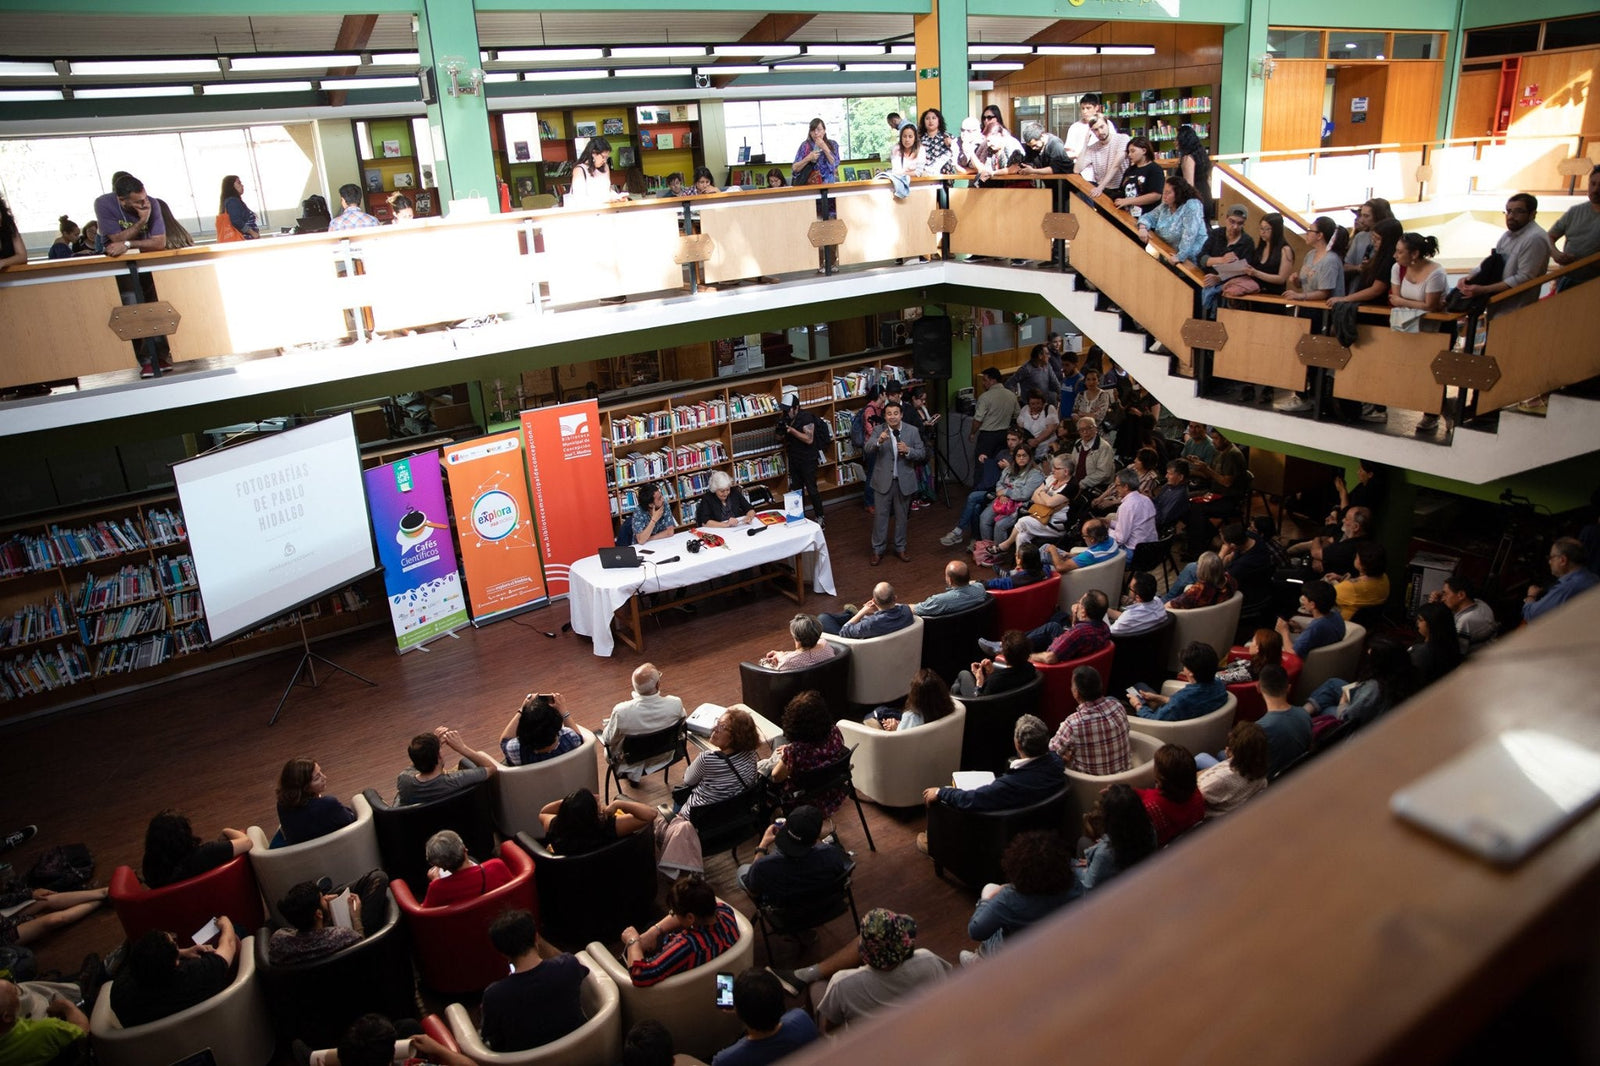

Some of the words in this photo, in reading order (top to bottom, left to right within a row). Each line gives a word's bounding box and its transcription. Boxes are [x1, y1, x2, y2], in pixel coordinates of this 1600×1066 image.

[236, 462, 309, 498] FOTOGRAFÍAS
[254, 495, 268, 512] DE
[272, 484, 305, 507] PABLO
[258, 503, 305, 532] HIDALGO
[478, 506, 512, 525] explora
[401, 548, 439, 567] Científicos
[415, 540, 438, 553] Cafés
